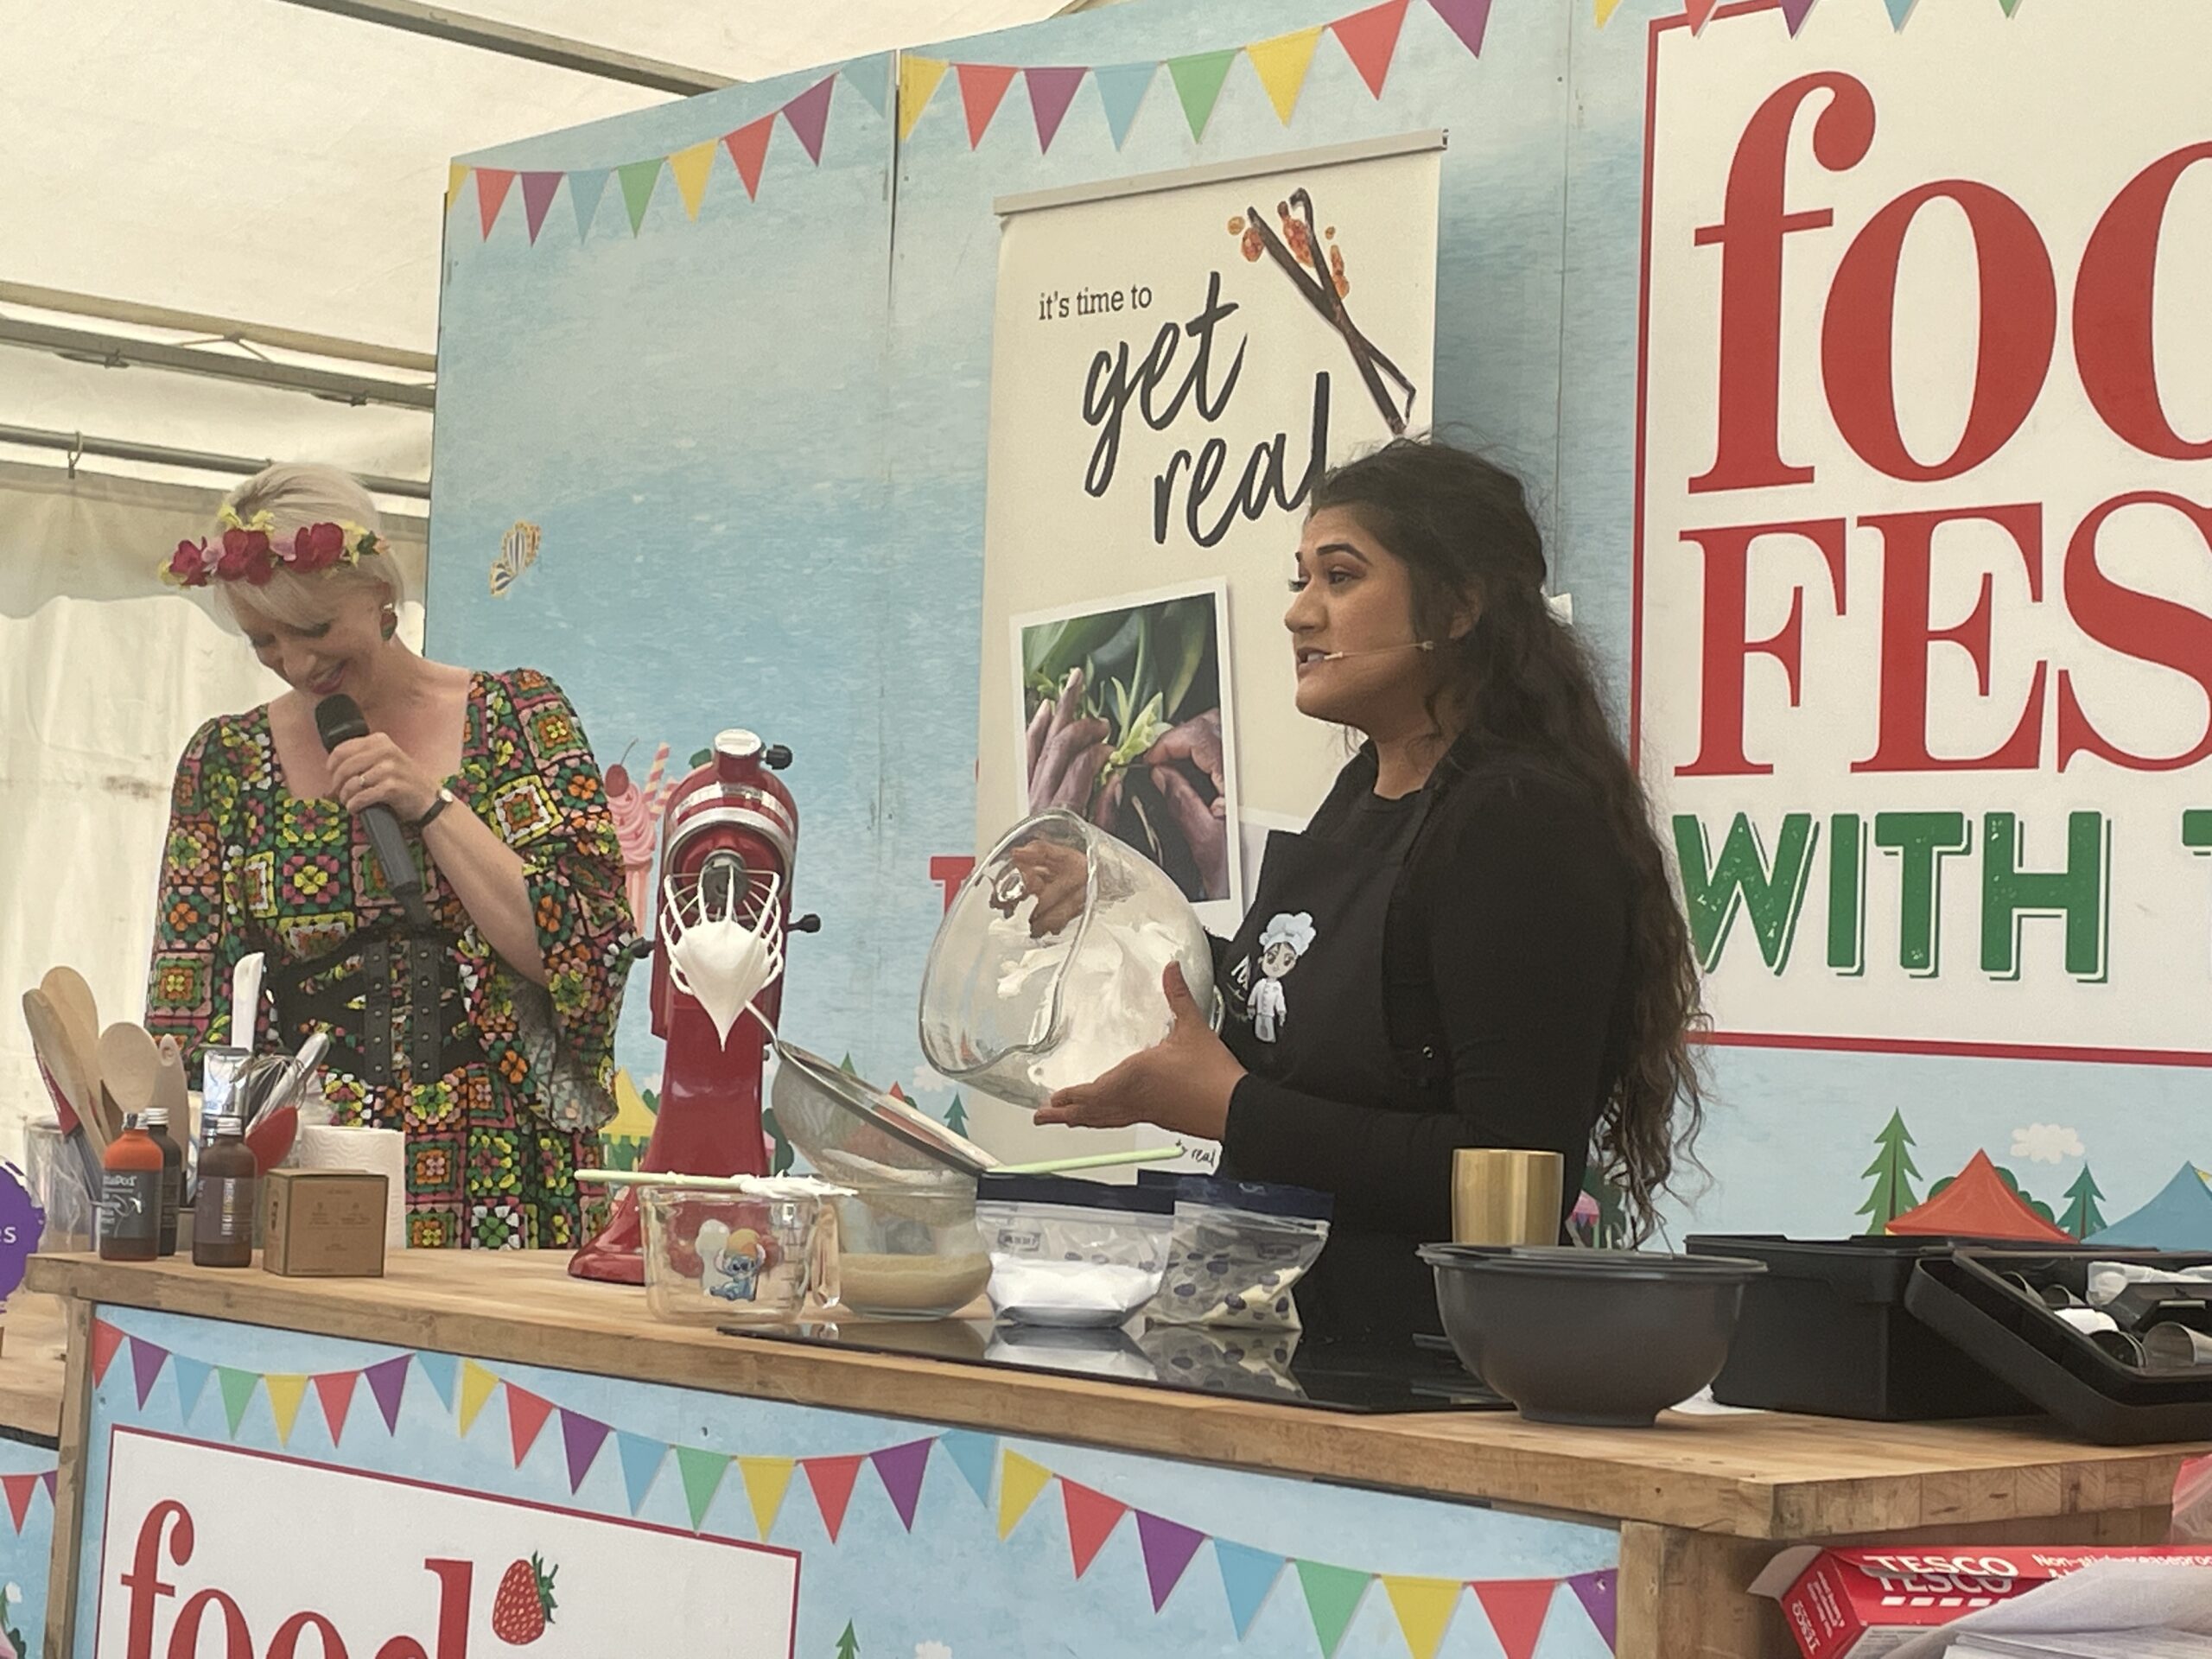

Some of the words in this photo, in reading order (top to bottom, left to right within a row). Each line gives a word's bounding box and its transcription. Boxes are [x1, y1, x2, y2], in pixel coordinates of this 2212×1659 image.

[1039, 292, 1070, 321] it's
[1077, 287, 1124, 315] time
[1131, 285, 1153, 309] to
[1082, 270, 1248, 498] get
[1154, 371, 1331, 548] real
[1674, 490, 2212, 777] FES
[1671, 810, 2112, 983] WITH
[1862, 1554, 2019, 1577] TESCO
